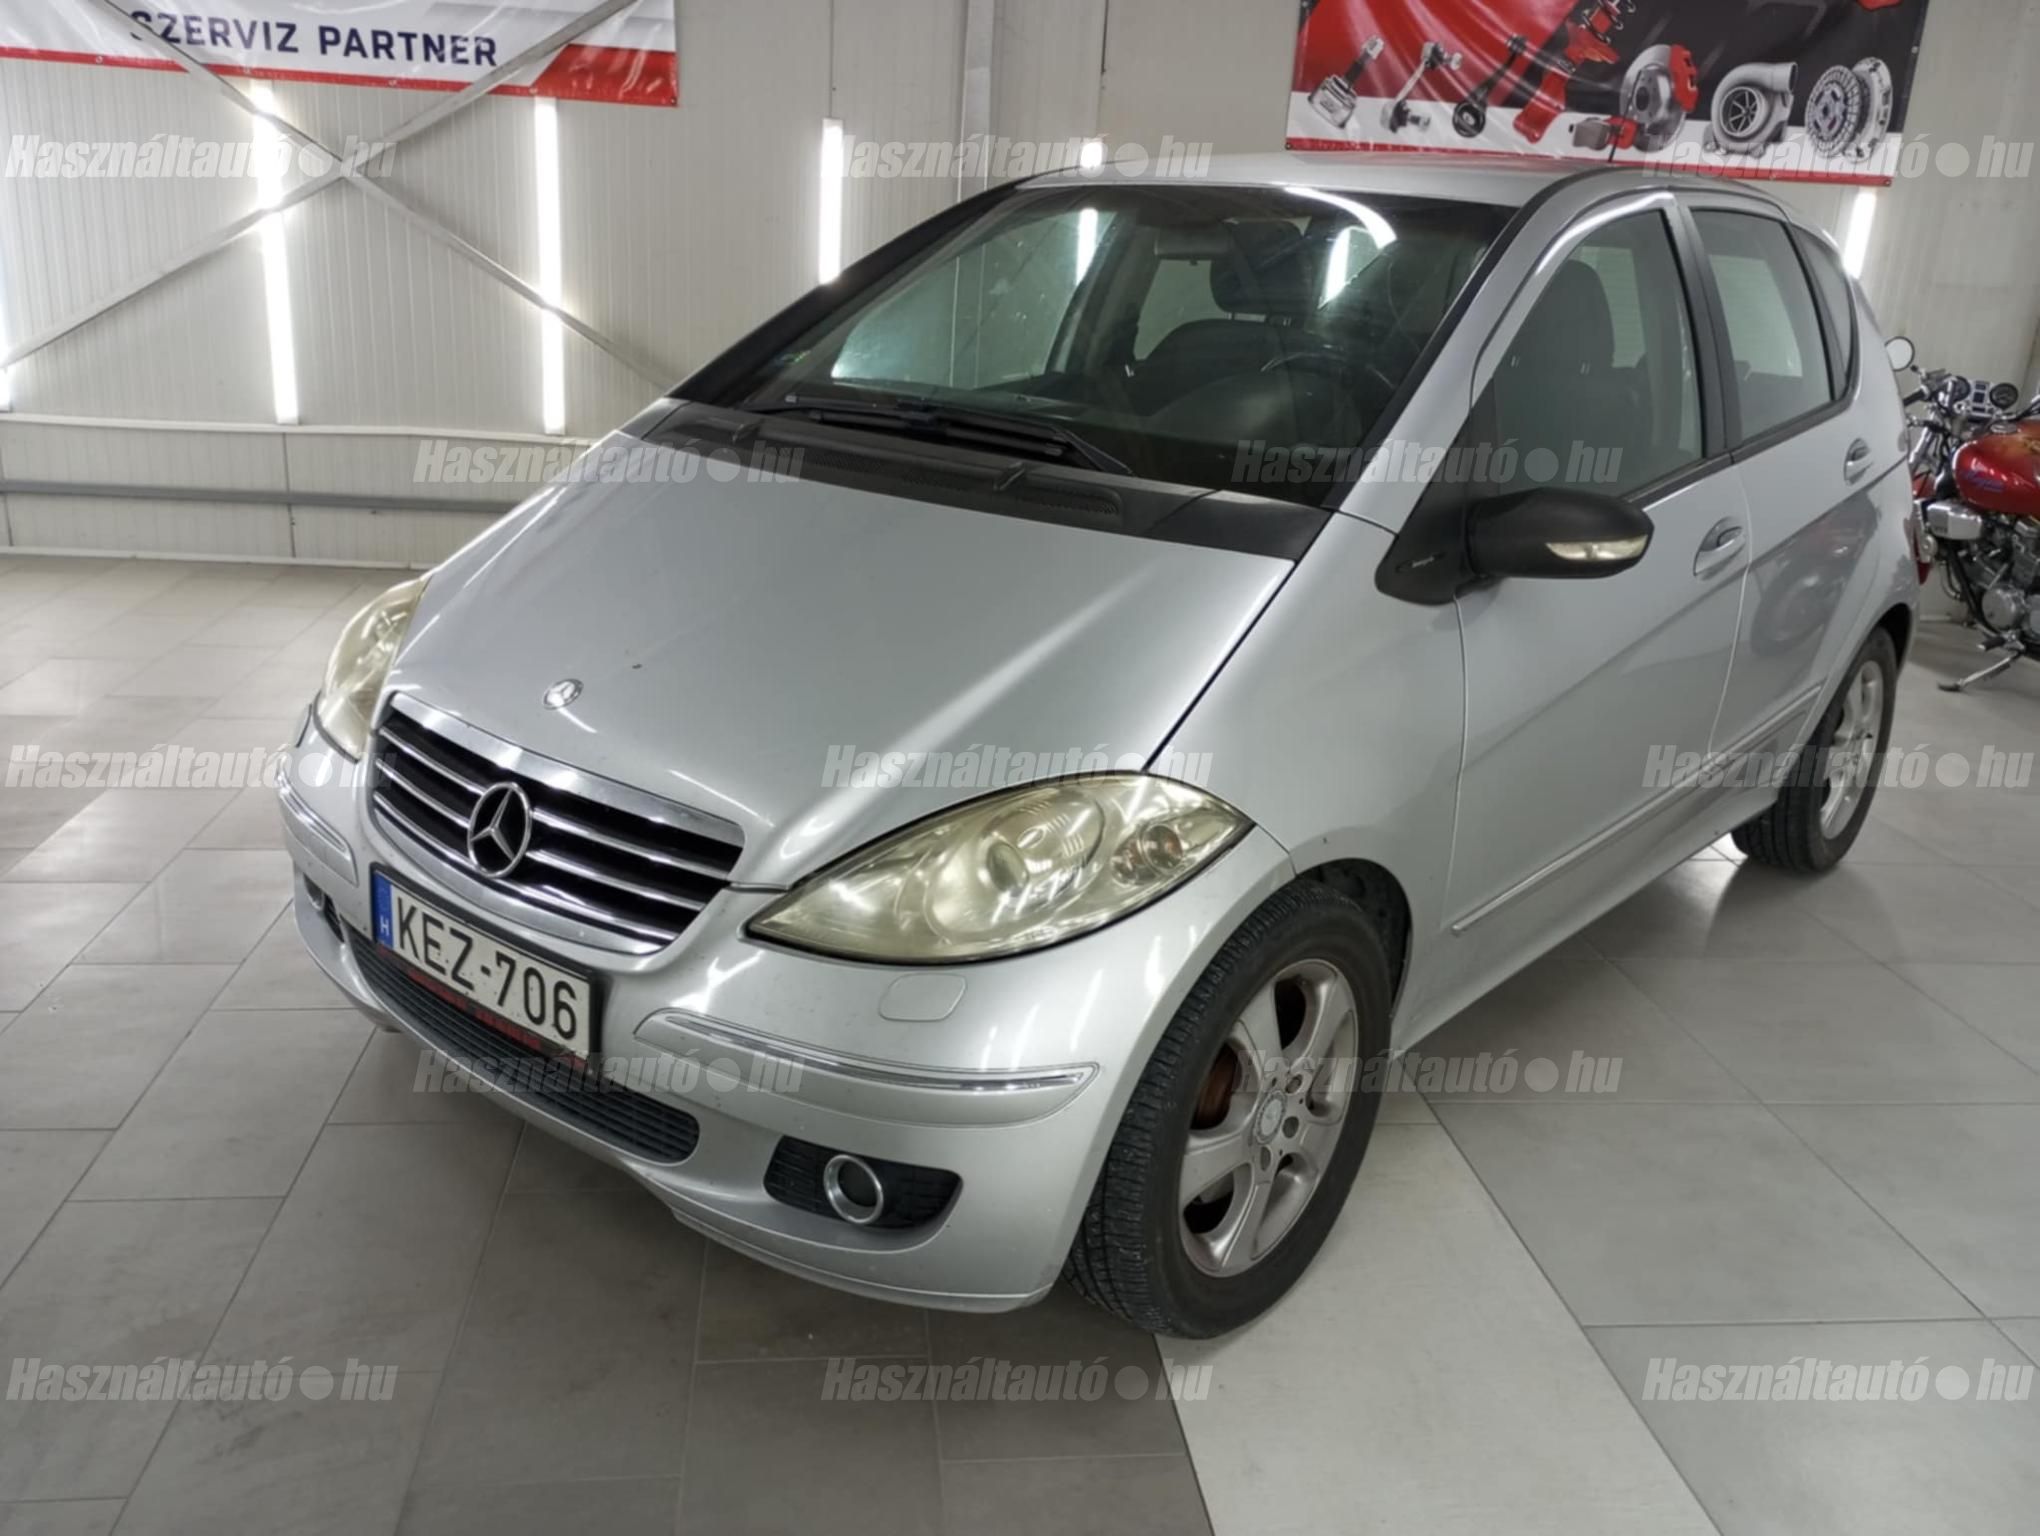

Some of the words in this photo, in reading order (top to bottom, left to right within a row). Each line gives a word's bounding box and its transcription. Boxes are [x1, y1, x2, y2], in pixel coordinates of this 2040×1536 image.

[318, 25, 498, 67] PARTNER
[379, 914, 391, 937] H
[397, 896, 577, 1041] KEZ-706
